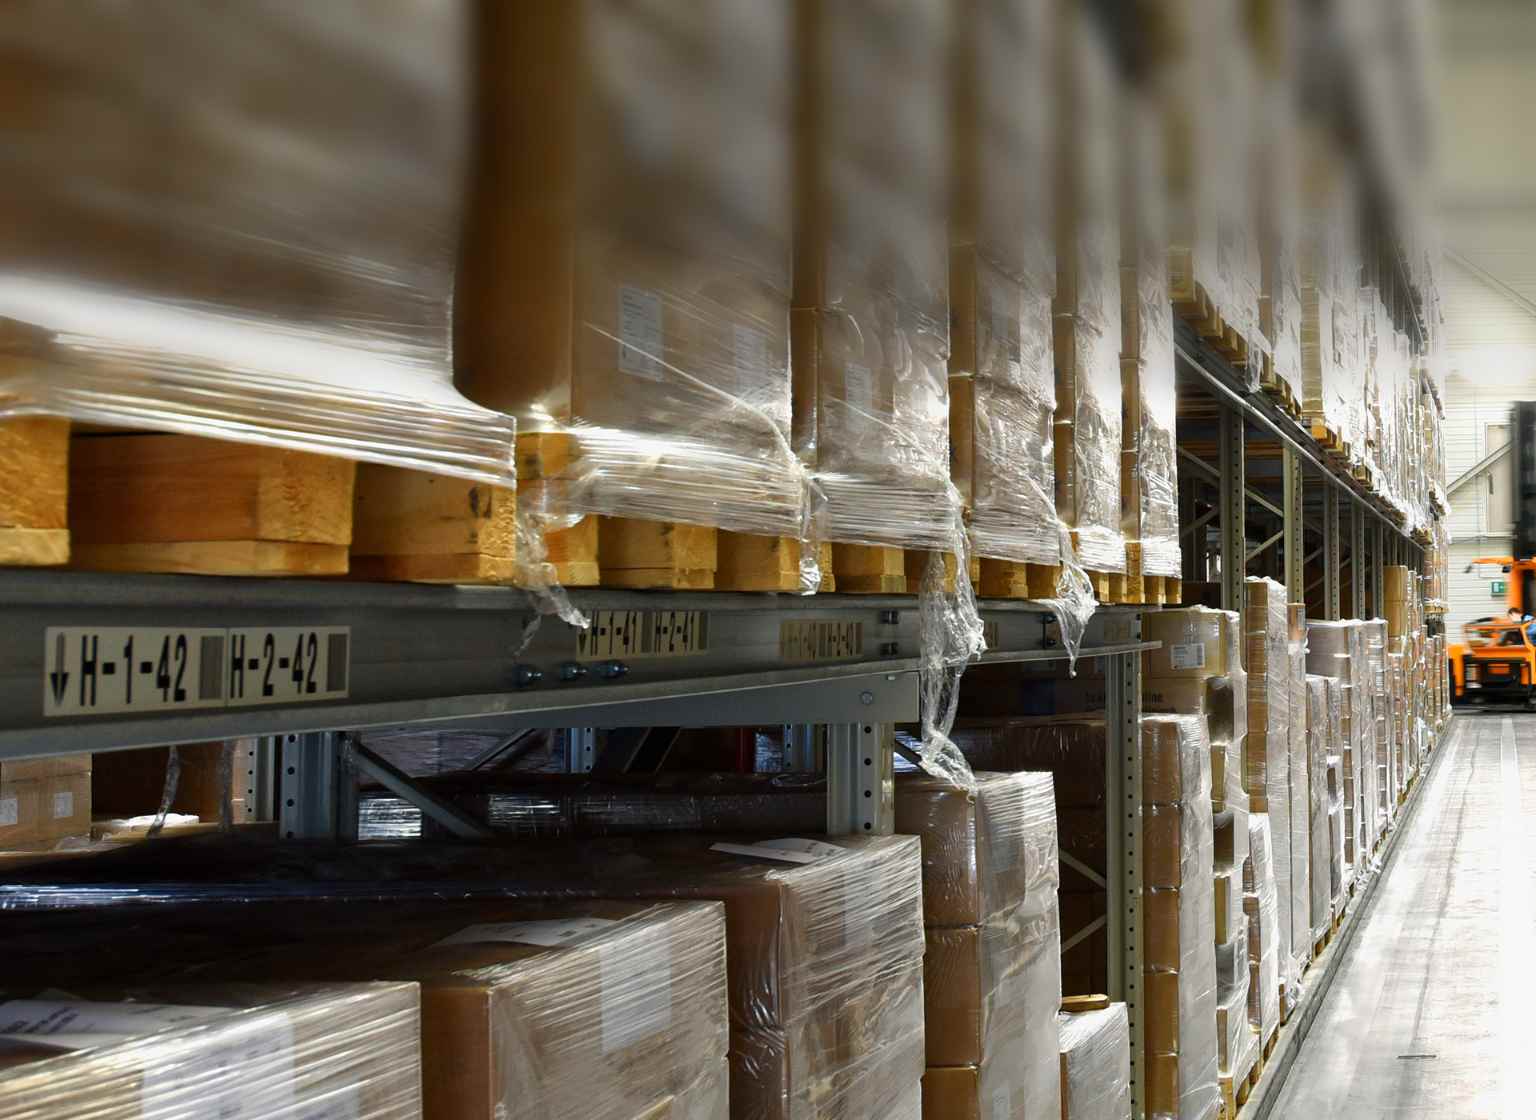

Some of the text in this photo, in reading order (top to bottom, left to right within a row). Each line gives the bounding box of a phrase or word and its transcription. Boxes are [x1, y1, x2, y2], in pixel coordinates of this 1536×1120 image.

[590, 610, 695, 656] H-1-41 H-2-41
[80, 632, 318, 705] H-1-42 H-2-42
